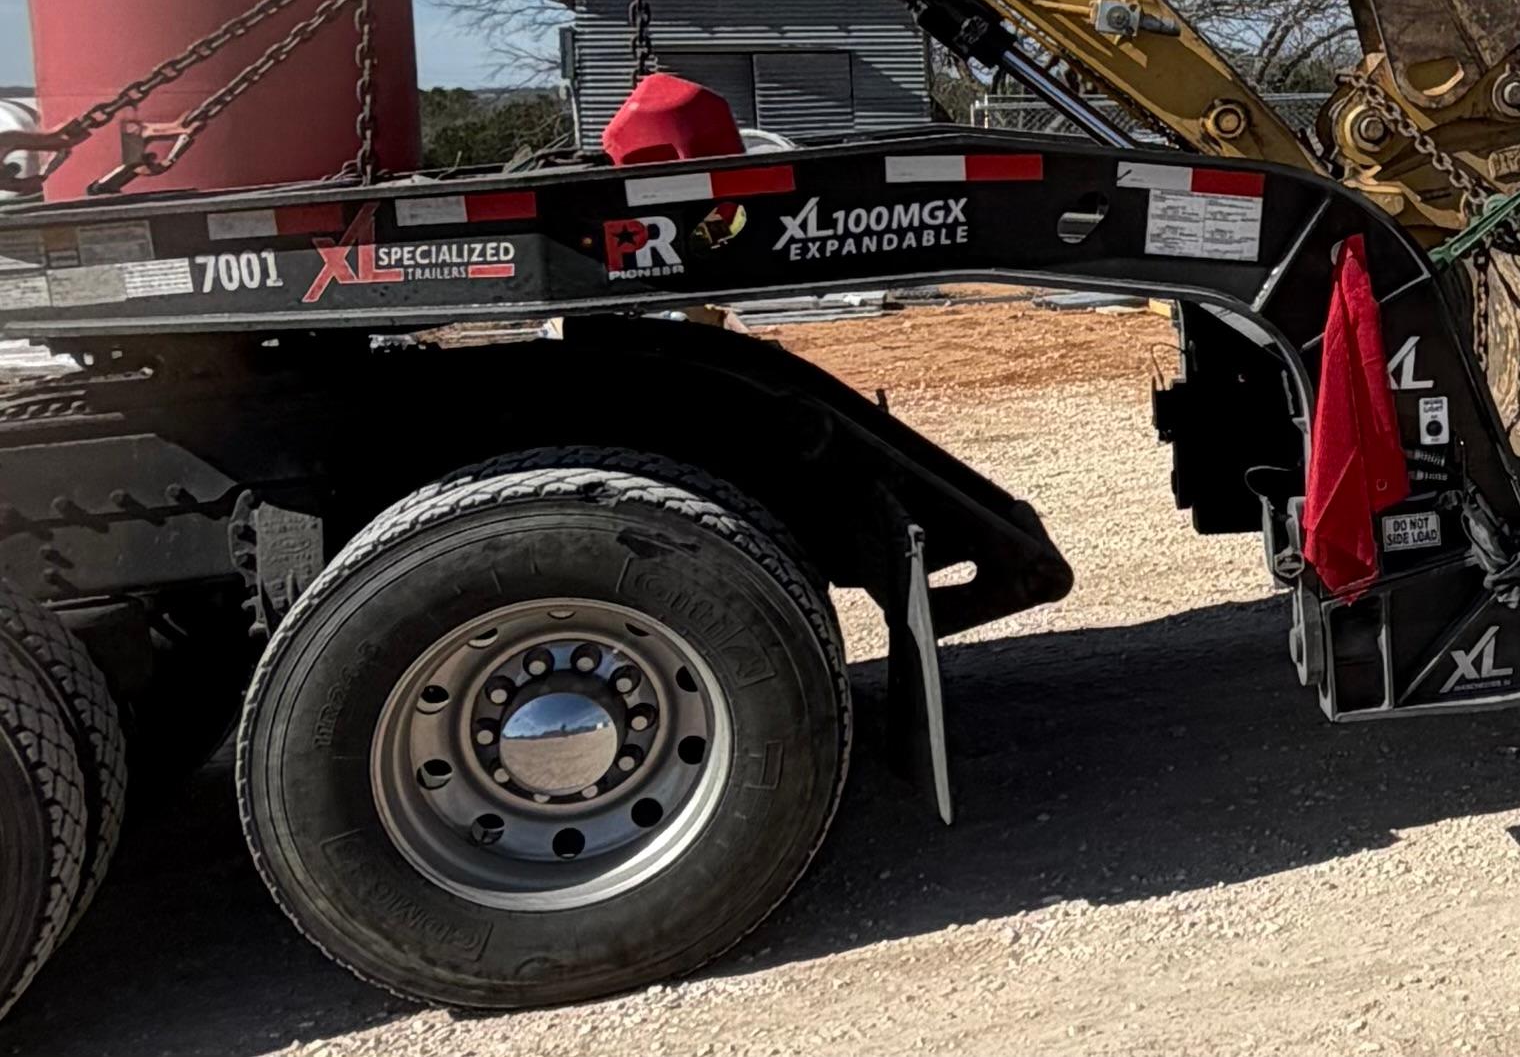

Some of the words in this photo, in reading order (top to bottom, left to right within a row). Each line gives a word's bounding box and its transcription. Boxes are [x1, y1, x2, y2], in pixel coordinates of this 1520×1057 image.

[302, 202, 405, 303] XL
[378, 242, 515, 266] SPECIALIZED
[789, 226, 968, 261] EXPANDABLE
[195, 250, 284, 293] 7001
[406, 265, 467, 281] TRAILERS
[608, 264, 685, 281] PIONEER
[1393, 520, 1407, 532] DO
[1410, 517, 1429, 530] NOT
[1387, 532, 1409, 546] SIDE
[1411, 529, 1437, 543] LOAD
[1439, 625, 1513, 694] XL
